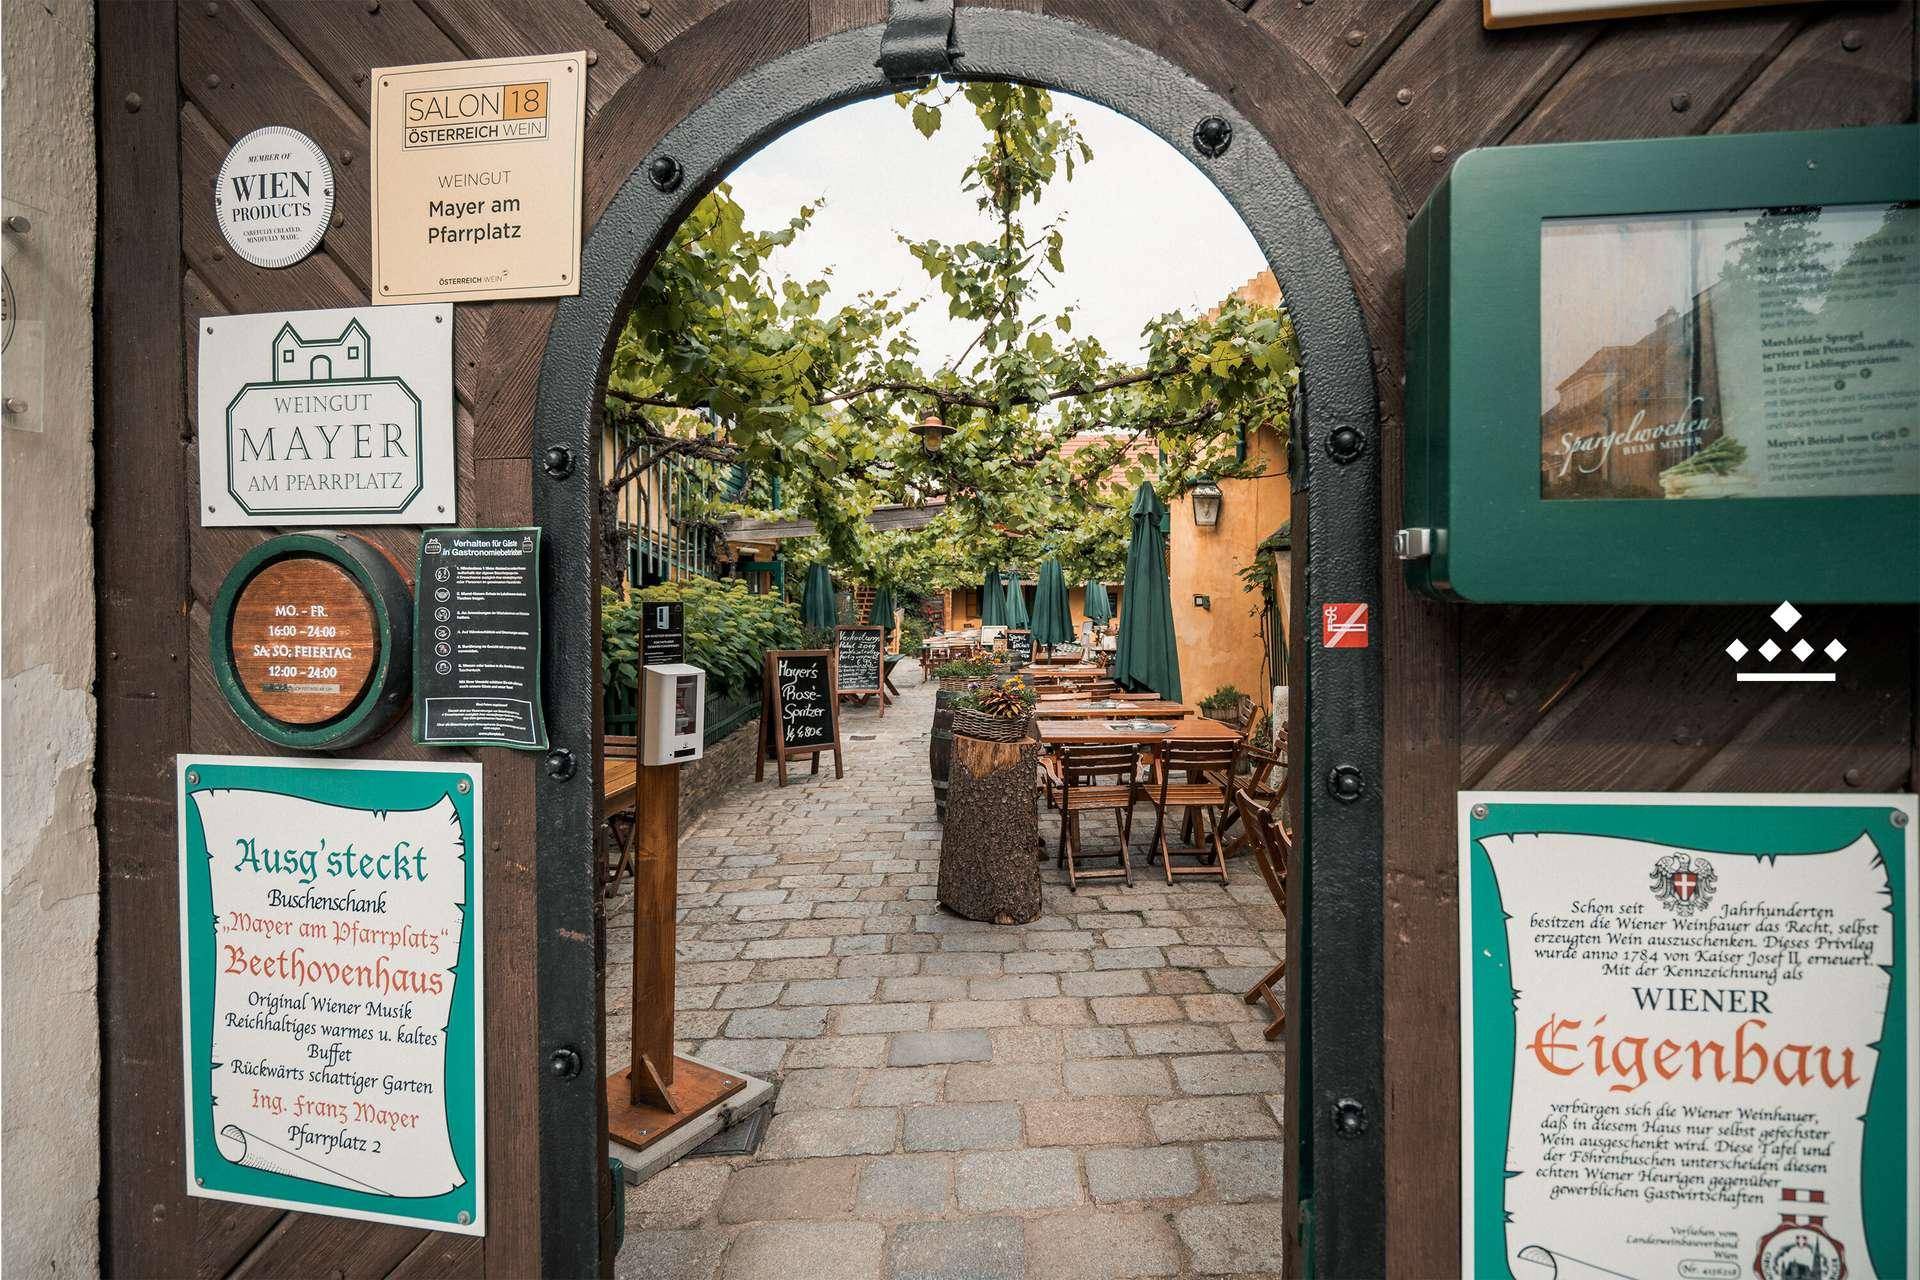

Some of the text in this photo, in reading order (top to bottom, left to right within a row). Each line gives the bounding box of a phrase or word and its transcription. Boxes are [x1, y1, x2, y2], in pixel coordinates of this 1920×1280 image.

[408, 88, 541, 122] SALON 18
[408, 121, 543, 144] ÖSTERREICH WEIN
[248, 152, 291, 163] MEMBER OF
[231, 170, 312, 202] WIEN
[438, 170, 511, 189] WEINGUT
[232, 202, 312, 222] PRODUCTS
[429, 197, 521, 221] Mayer am
[243, 228, 272, 237] CAREFULLY
[247, 235, 278, 243] MINDFULLY
[428, 223, 521, 245] Pfarrplatz
[439, 277, 481, 286] ÖSTERREICH
[274, 394, 372, 414] WEINGUT
[240, 423, 409, 462] MAYER
[248, 472, 402, 492] AM PFARRPLATZ
[442, 548, 450, 556] in
[454, 539, 490, 547] Verhalten
[492, 539, 501, 547] für
[275, 606, 299, 617] MO.
[268, 626, 296, 637] 16:00
[307, 625, 336, 637] 24:00
[294, 646, 352, 659] FEIERTAG
[268, 666, 297, 677] 12:00
[307, 666, 337, 678] 24:00
[779, 660, 818, 689] Mayer's
[783, 703, 826, 724] Spritzer
[234, 837, 429, 885] Ausg'steckt
[267, 887, 387, 914] Buschenschank
[1570, 898, 1834, 919] Schon seit Jahrhunderten
[299, 923, 327, 939] am
[1530, 912, 1880, 937] besitzen die Wiener Weinbauer das Recht, selbst
[1534, 932, 1874, 956] erzeugten Wein auszuschenken. Dieses Privileg
[1534, 945, 1577, 960] wurde
[1582, 949, 1618, 961] anno
[1623, 948, 1658, 963] 1784
[1663, 951, 1689, 962] von
[1694, 950, 1744, 963] Kaiser
[1747, 950, 1785, 967] Josef
[1807, 953, 1873, 967] erneuert.
[224, 945, 443, 996] Beethovenhaus
[1602, 961, 1803, 986] Mit der Kennzeichnung als
[248, 991, 413, 1019] Original Wiener Musik
[1632, 987, 1773, 1014] WIENER
[225, 1013, 438, 1046] Reichhaltiges warmes u. kaltes
[307, 1043, 352, 1067] Buffet
[1526, 1012, 1861, 1094] Eigenbau
[230, 1059, 433, 1095] Rückwärts schattiger Garten
[252, 1089, 420, 1132] Ing. Franz Mayer
[1551, 1098, 1819, 1124] verbürgen sich die Wiener Weinhauer,
[1540, 1114, 1568, 1135] daß
[1573, 1118, 1587, 1130] in
[1591, 1118, 1637, 1133] diesem
[1641, 1117, 1681, 1134] Haus
[1686, 1125, 1713, 1136] nur
[1718, 1121, 1755, 1137] selbst
[288, 1123, 383, 1154] Pfarrplatz 2
[1540, 1132, 1574, 1146] Wein
[1579, 1134, 1670, 1154] ausgeschenkt
[1714, 1139, 1753, 1153] Diese
[1758, 1140, 1797, 1162] Tafel
[1803, 1141, 1835, 1157] und
[1543, 1147, 1827, 1173] der Föhrenbuschen unterscheiden diesen
[1536, 1163, 1782, 1193] echten Wiener Heurigen gegenüber
[1549, 1181, 1764, 1209] gewerblichen Gastwirtschaften
[1713, 1250, 1738, 1259] Wien
